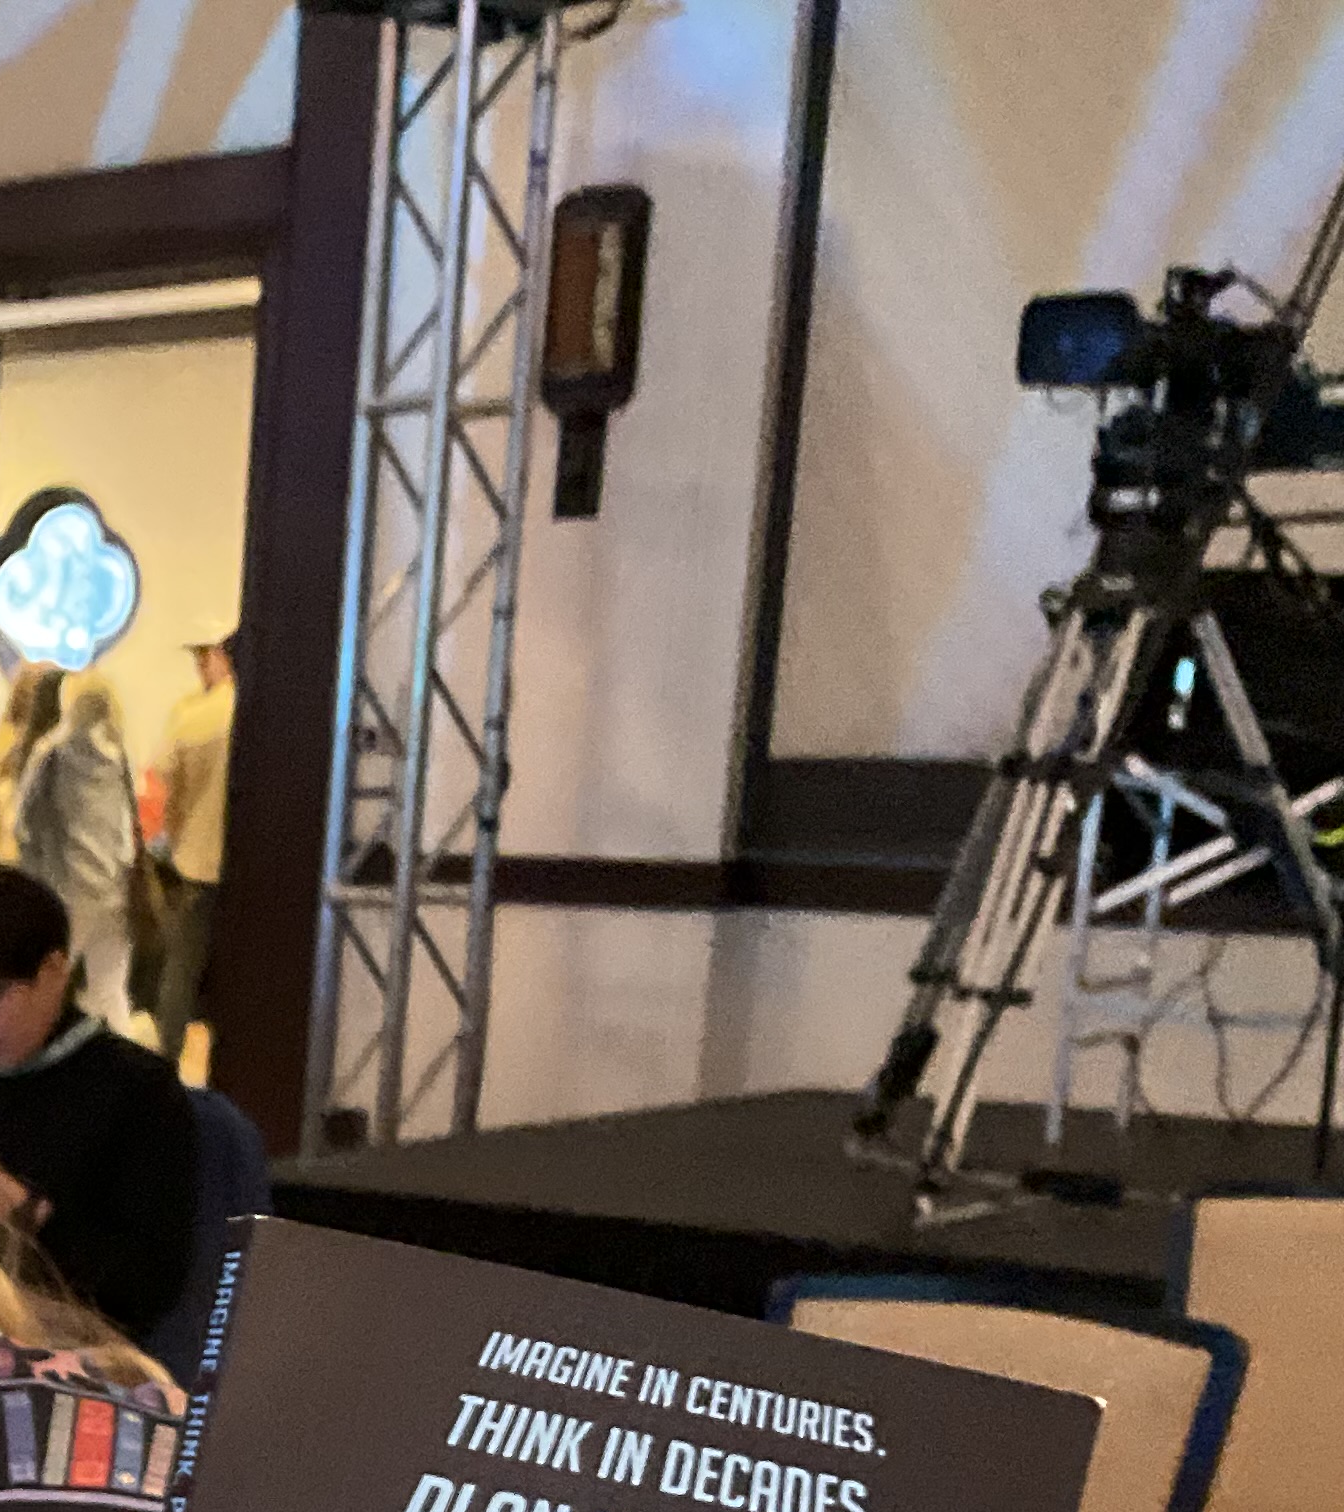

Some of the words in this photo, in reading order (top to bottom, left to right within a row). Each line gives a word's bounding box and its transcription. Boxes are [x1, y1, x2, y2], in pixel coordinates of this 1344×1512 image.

[446, 1393, 593, 1473] THINK
[597, 1426, 655, 1487] IN
[478, 1331, 635, 1399] IMAGINE
[638, 1364, 680, 1408] IN
[685, 1375, 888, 1457] CENTURIES.
